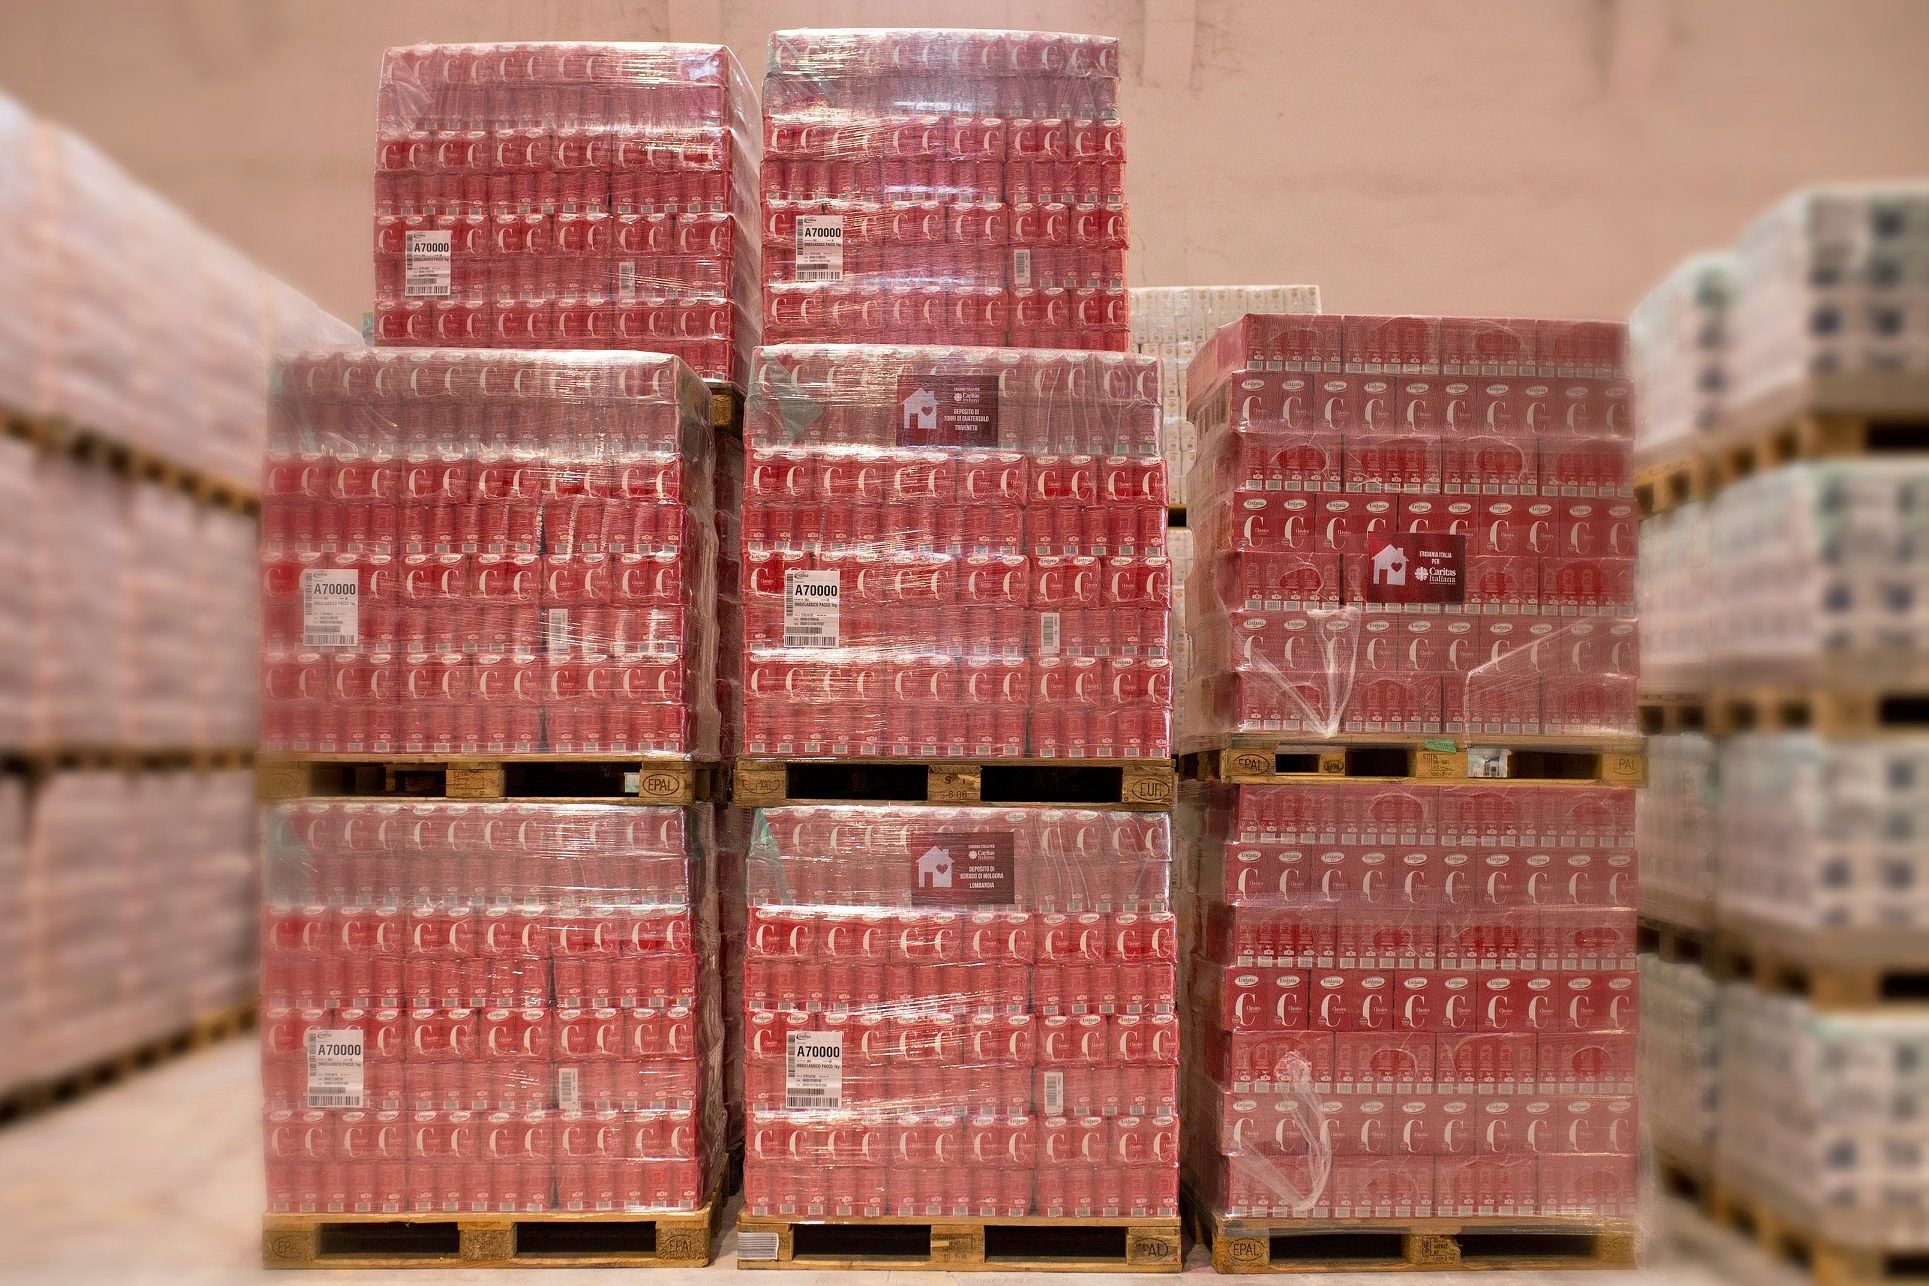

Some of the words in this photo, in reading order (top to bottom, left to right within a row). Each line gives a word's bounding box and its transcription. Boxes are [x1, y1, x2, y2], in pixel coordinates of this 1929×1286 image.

[498, 56, 514, 82] C
[438, 144, 452, 168] C
[983, 130, 998, 156] C
[1075, 132, 1090, 156] C
[466, 228, 481, 254] C
[558, 226, 574, 252] C
[805, 228, 841, 238] A70000
[984, 216, 1000, 240] C
[1046, 215, 1062, 241] C
[414, 243, 449, 252] A70000
[438, 314, 452, 338] C
[526, 312, 542, 338] C
[985, 300, 1000, 326] C
[1107, 300, 1122, 324] C
[1243, 396, 1262, 428] C
[1325, 398, 1343, 429] C
[1487, 401, 1506, 432] C
[337, 467, 355, 498] C
[408, 468, 426, 497] C
[786, 466, 804, 495] C
[1071, 470, 1089, 499] C
[1244, 515, 1263, 548] C
[1285, 516, 1304, 548] C
[1327, 517, 1346, 549] C
[1490, 520, 1508, 552] C
[1530, 521, 1548, 553] C
[478, 569, 497, 598] C
[621, 569, 640, 598] C
[1074, 571, 1092, 600] C
[1429, 567, 1456, 576] Caritas
[314, 583, 356, 595] A70000
[795, 585, 837, 596] A70000
[1111, 571, 1129, 602] C
[1367, 638, 1385, 670] C
[1449, 639, 1468, 671] C
[336, 668, 354, 697] C
[479, 670, 497, 699] C
[751, 668, 767, 697] C
[1002, 672, 1021, 701] C
[648, 779, 673, 791] EPAL
[1140, 782, 1162, 797] EUR
[344, 819, 362, 848] C
[1238, 868, 1258, 901] C
[1362, 870, 1382, 903] C
[1487, 871, 1507, 904] C
[414, 922, 430, 953] C
[755, 924, 774, 953] C
[972, 929, 991, 958] C
[1235, 993, 1256, 1026] C
[1277, 993, 1297, 1026] C
[1321, 994, 1341, 1027] C
[1363, 994, 1382, 1027] C
[1405, 994, 1425, 1028] C
[1446, 995, 1465, 1028] C
[1488, 995, 1507, 1028] C
[1528, 995, 1548, 1029] C
[1569, 996, 1589, 1028] C
[318, 1044, 361, 1056] A70000
[488, 1026, 506, 1055] C
[634, 1023, 652, 1054] C
[797, 1046, 840, 1058] A70000
[1009, 1031, 1027, 1060] C
[489, 1128, 507, 1157] C
[1119, 1133, 1137, 1162] C
[1153, 1131, 1171, 1162] C
[1361, 1119, 1380, 1152] C
[1487, 1120, 1506, 1152] C
[1233, 1243, 1259, 1256] EPAL
